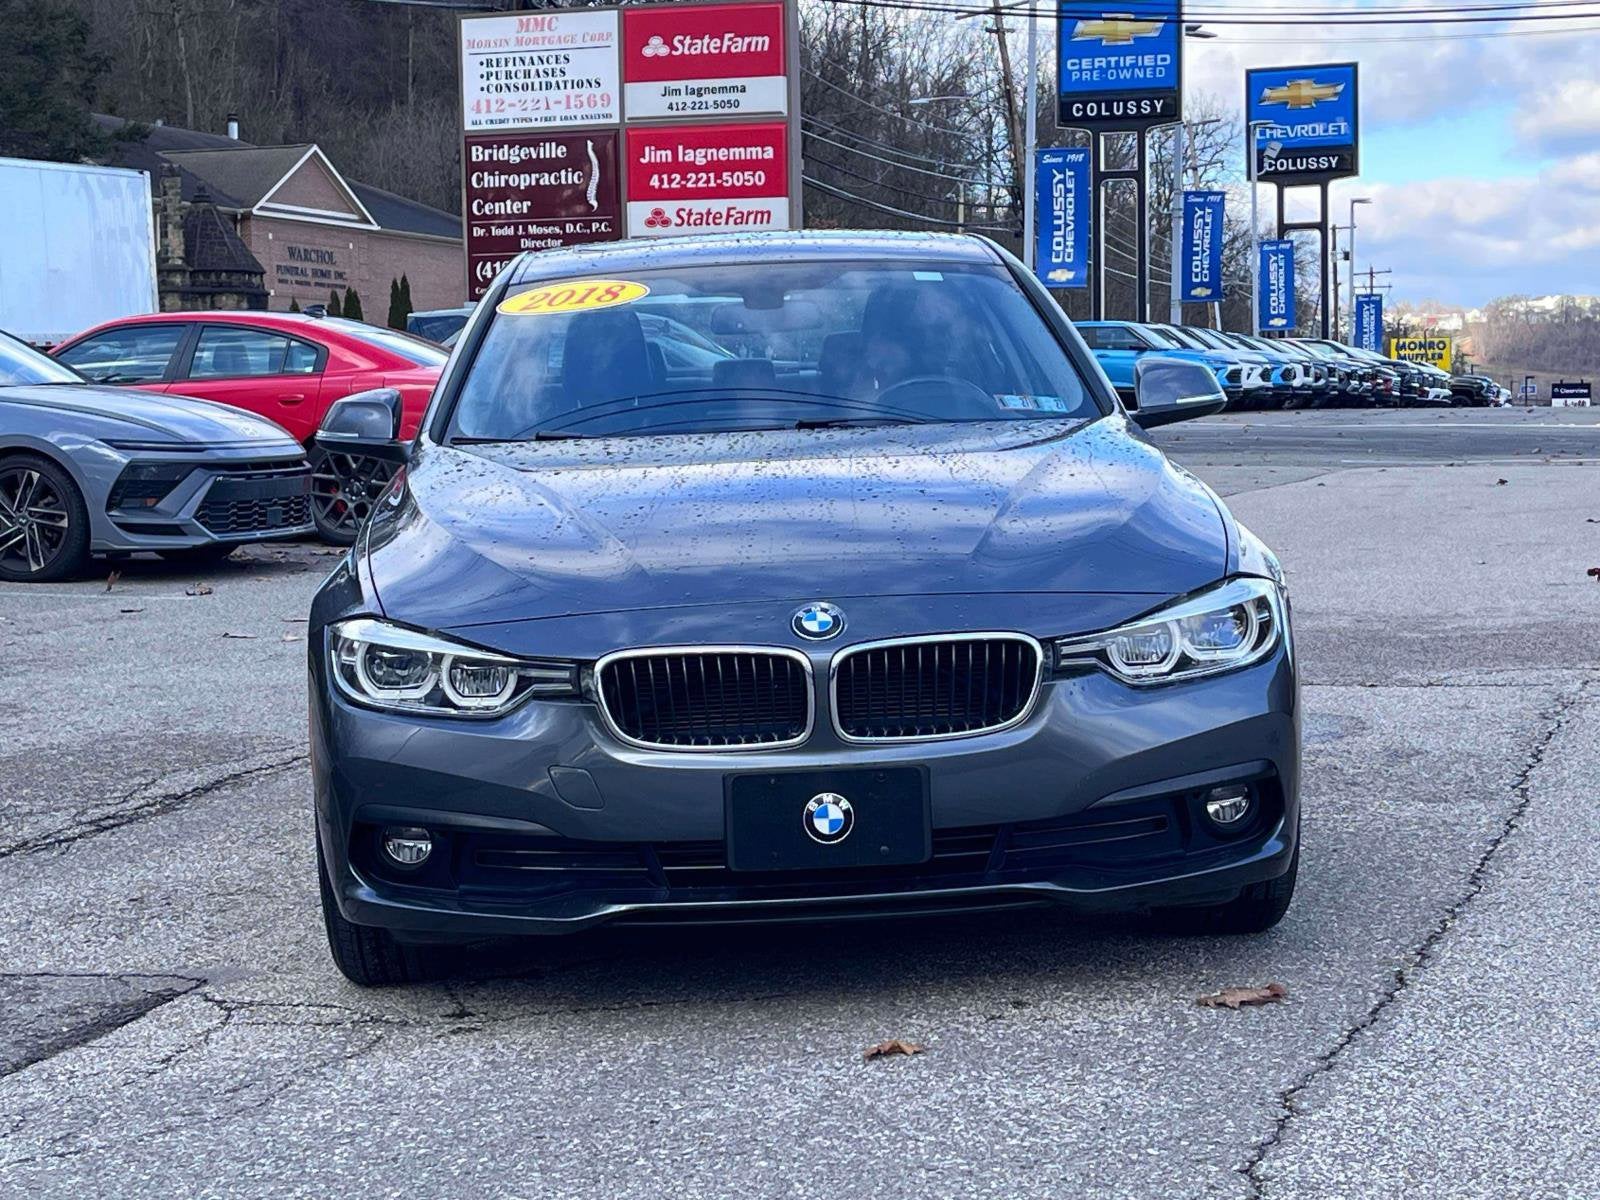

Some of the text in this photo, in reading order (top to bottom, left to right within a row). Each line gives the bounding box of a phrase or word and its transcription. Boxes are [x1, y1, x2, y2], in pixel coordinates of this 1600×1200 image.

[516, 16, 559, 33] MMC
[514, 33, 577, 47] MORTGAGE
[486, 53, 570, 69] REFINANCES
[1066, 54, 1171, 71] CERTIFIED
[486, 67, 566, 81] PURCHASES
[1071, 67, 1166, 82] PRE-OWNED
[486, 78, 601, 94] CONSOLIDATIONS
[661, 83, 747, 98] Jim Iagnemma
[471, 92, 612, 114] 412-221-1569
[667, 98, 740, 112] 412-221-5050
[1072, 99, 1164, 117] COLUSSY
[1256, 122, 1348, 139] CHEVROLET
[471, 142, 567, 163] Bridgeville
[639, 145, 774, 165] Jim Iagnemma
[1266, 156, 1339, 171] COLUSSY
[471, 168, 584, 190] Chiropractic
[649, 171, 766, 189] 412-221-5050
[472, 199, 531, 215] Center
[1051, 168, 1065, 263] COLUSSY
[1064, 168, 1075, 263] CHEVROLET
[472, 226, 489, 237] Dr.
[491, 225, 514, 236] Todd
[517, 225, 526, 235] J.
[528, 224, 563, 235] Moses,
[592, 221, 612, 233] P.C.
[520, 238, 564, 249] Director
[1192, 206, 1204, 283] COLUSSY
[1202, 206, 1213, 282] CHEVROLET
[287, 246, 337, 265] WARCHOL
[519, 284, 626, 312] 2018
[1395, 340, 1447, 351] MONRO
